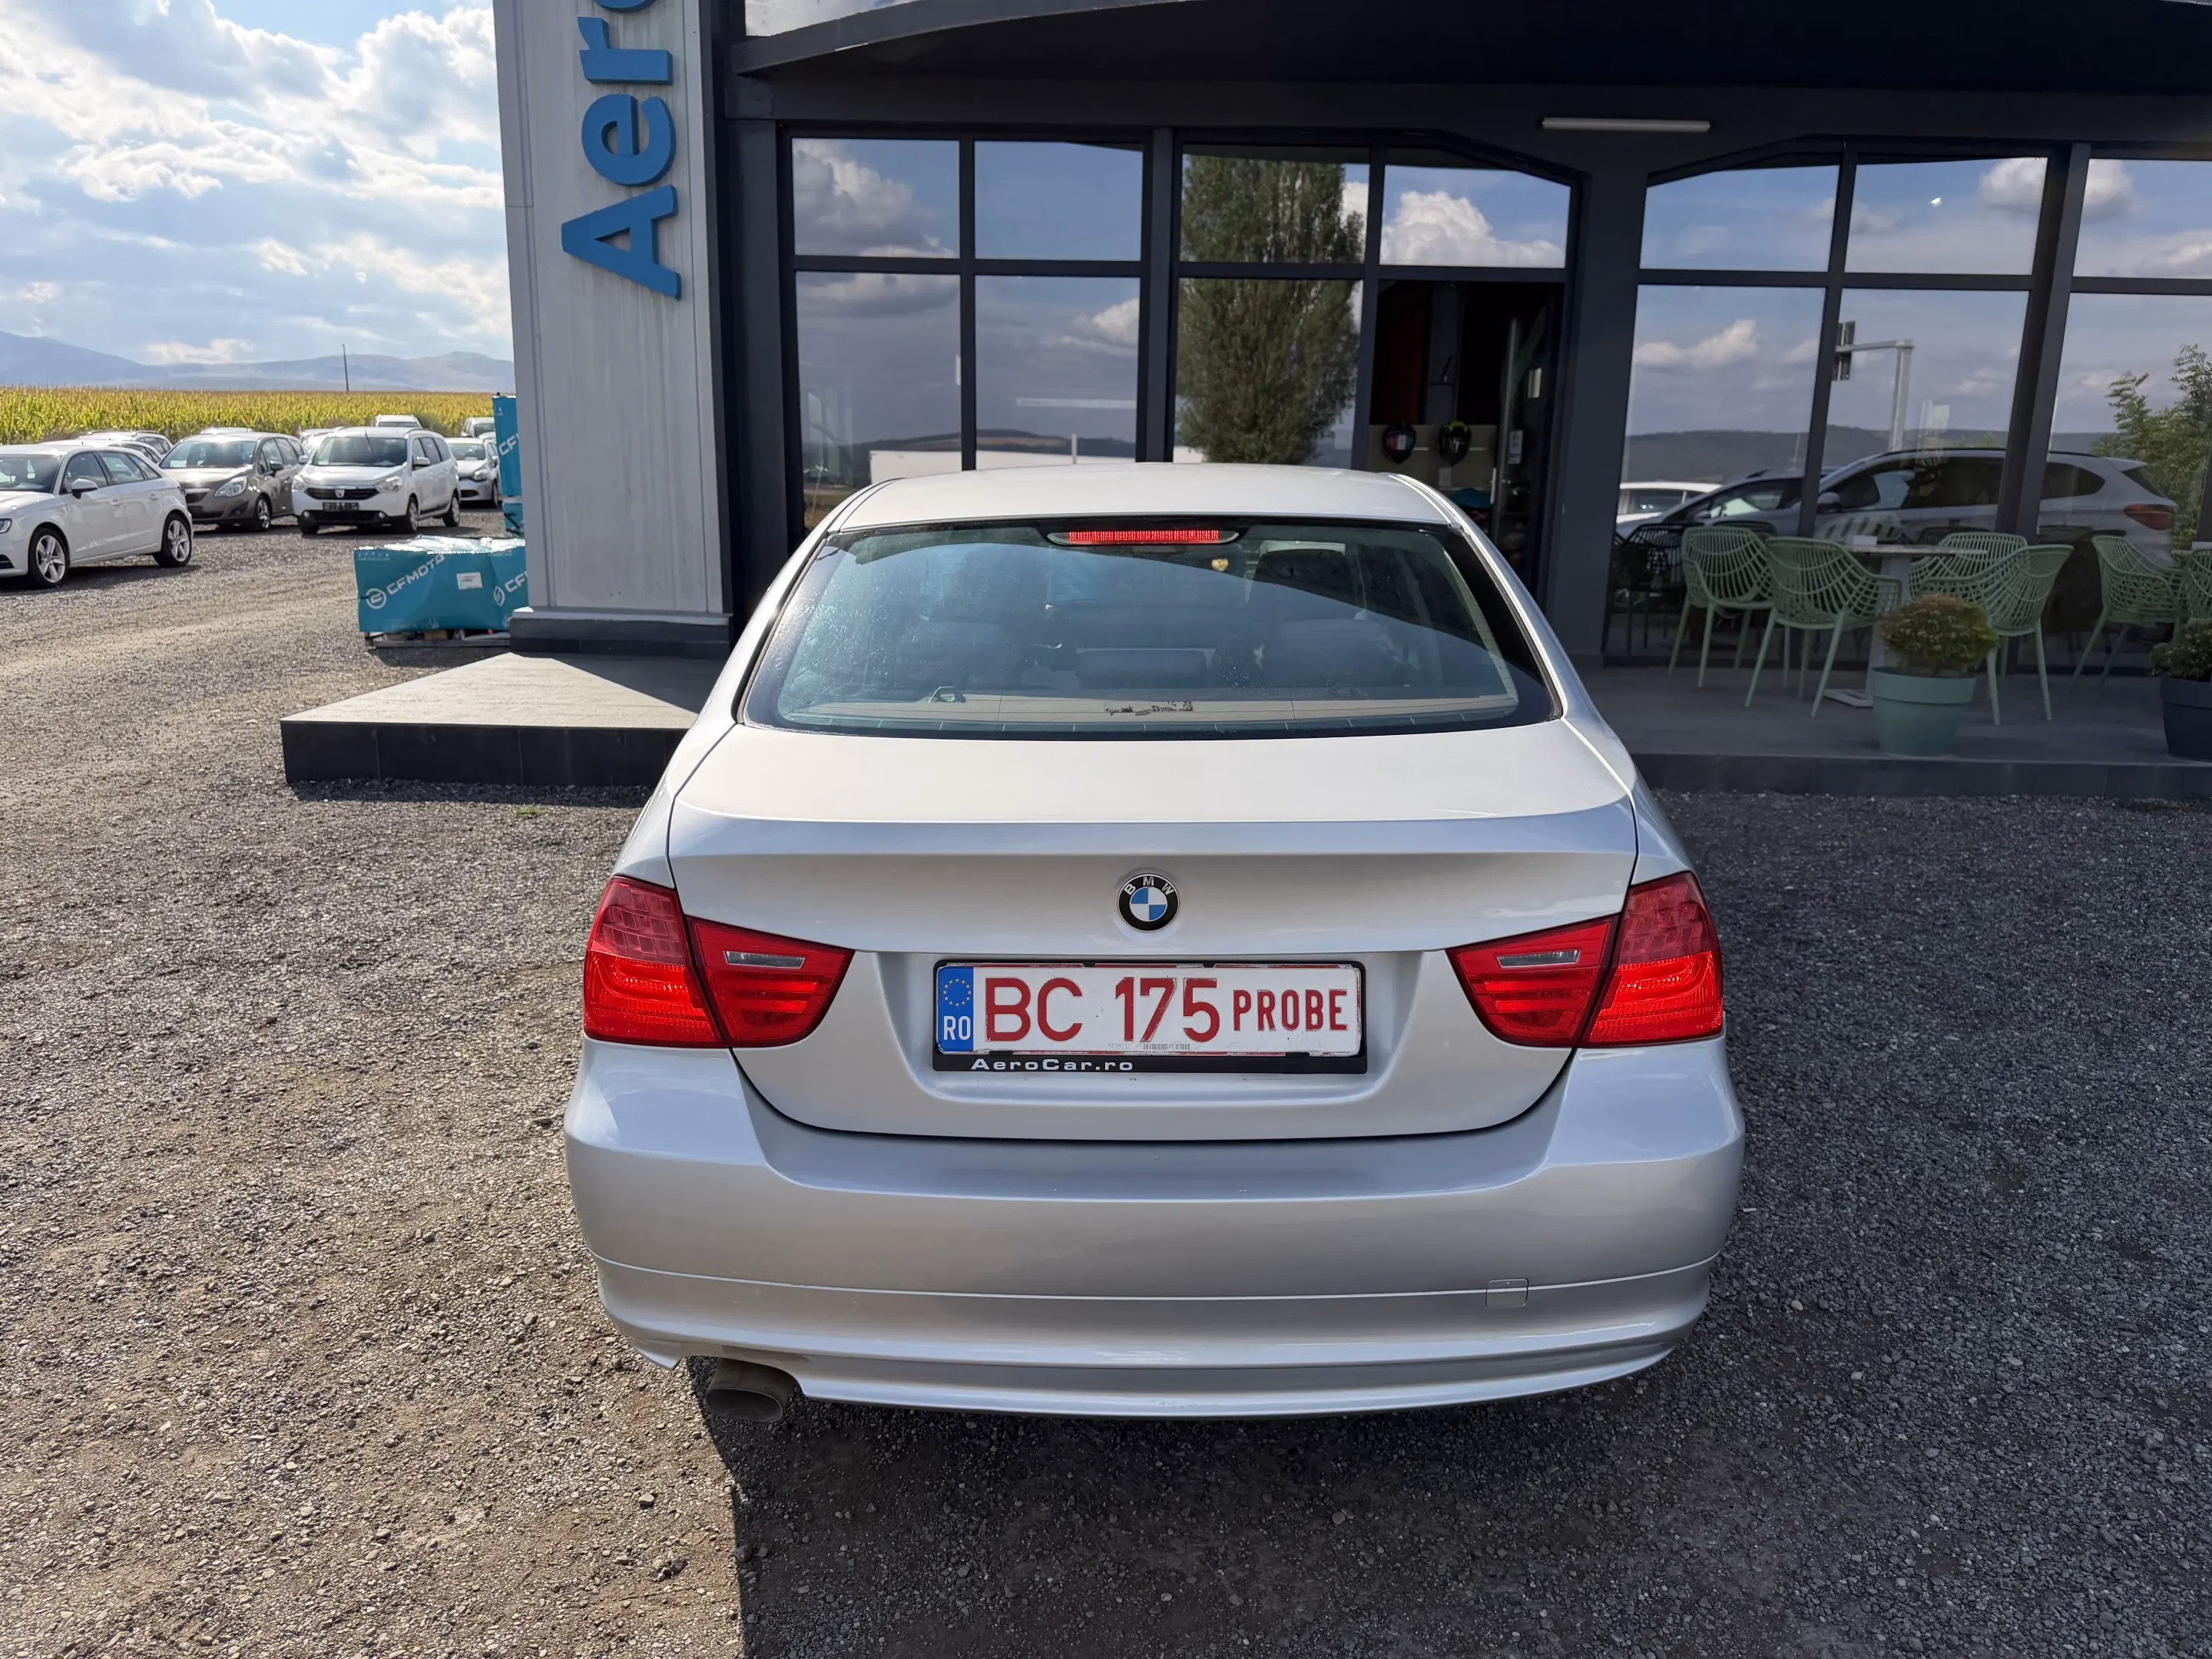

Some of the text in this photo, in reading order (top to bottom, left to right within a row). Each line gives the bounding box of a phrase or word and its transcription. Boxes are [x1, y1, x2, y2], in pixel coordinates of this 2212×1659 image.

[561, 0, 681, 300] Aer
[499, 433, 518, 455] CF
[386, 554, 445, 594] CFMOTO
[505, 571, 528, 592] CF
[1124, 876, 1174, 896] BMW
[985, 977, 1348, 1042] BC 175 PROBE
[943, 1015, 971, 1040] RO
[971, 1058, 1133, 1071] AeroCar.ro
